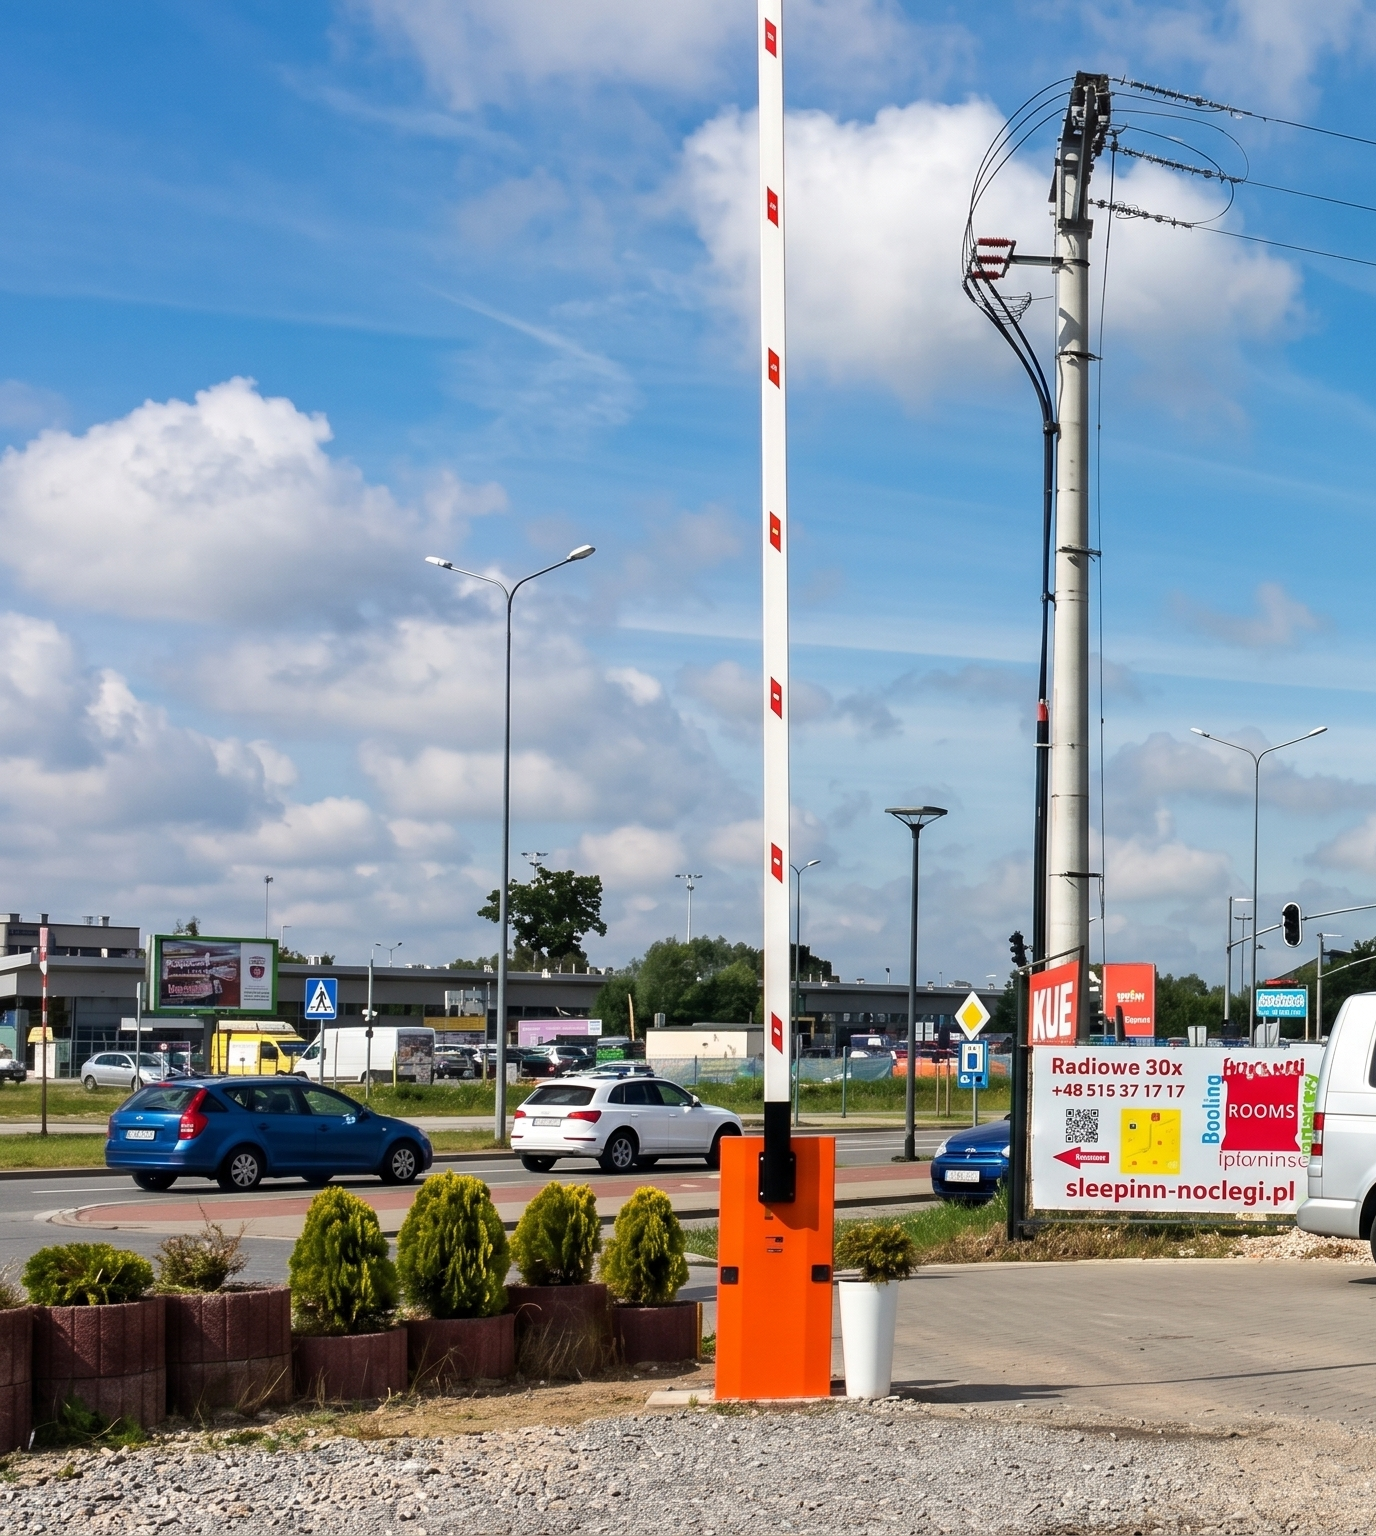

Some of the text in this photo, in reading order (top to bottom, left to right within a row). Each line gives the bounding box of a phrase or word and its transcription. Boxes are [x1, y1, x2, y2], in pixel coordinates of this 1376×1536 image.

[1033, 981, 1073, 1040] KUE
[1052, 1057, 1183, 1076] Radiowe 30x
[1051, 1083, 1186, 1098] +48 515 37 17 17
[1229, 1103, 1295, 1119] ROOMS
[1066, 1177, 1295, 1207] sleepinn-noclegi.pl
